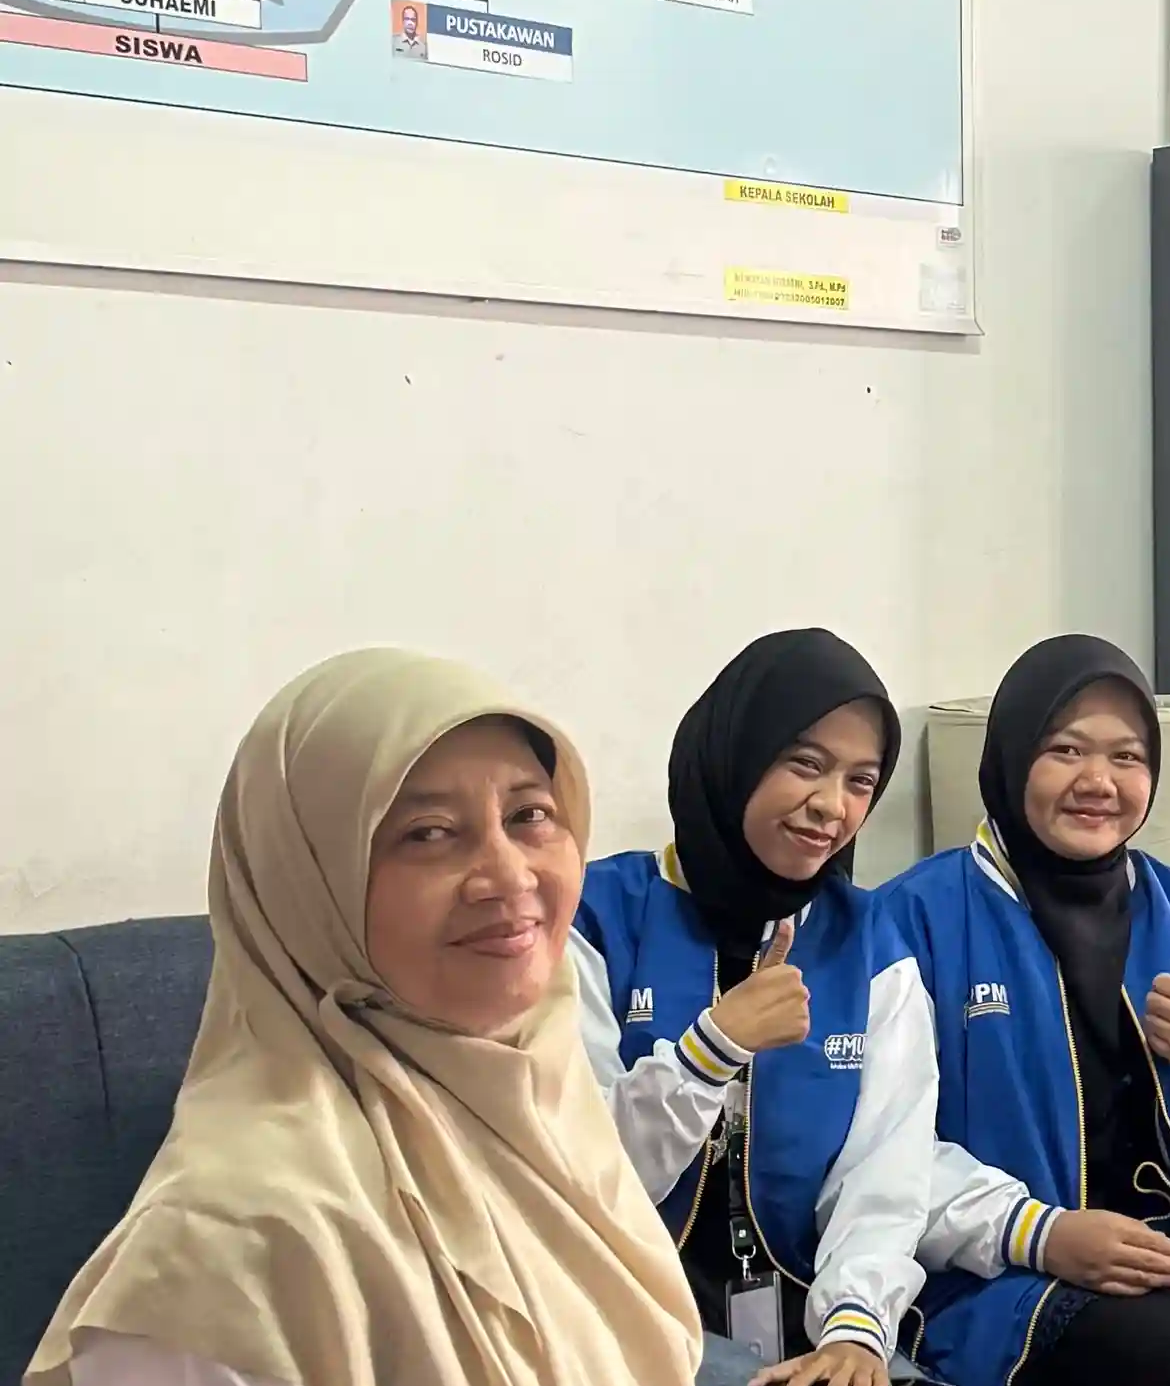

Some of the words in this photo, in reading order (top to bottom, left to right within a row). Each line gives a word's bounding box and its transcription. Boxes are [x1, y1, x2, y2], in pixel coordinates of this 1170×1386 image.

[446, 14, 554, 49] PUSTAKAWAN
[115, 34, 203, 64] SISWA
[482, 48, 523, 67] ROSID
[739, 185, 782, 202] KEPALA
[785, 191, 835, 209] SEKOLAH
[970, 982, 1009, 1004] PM
